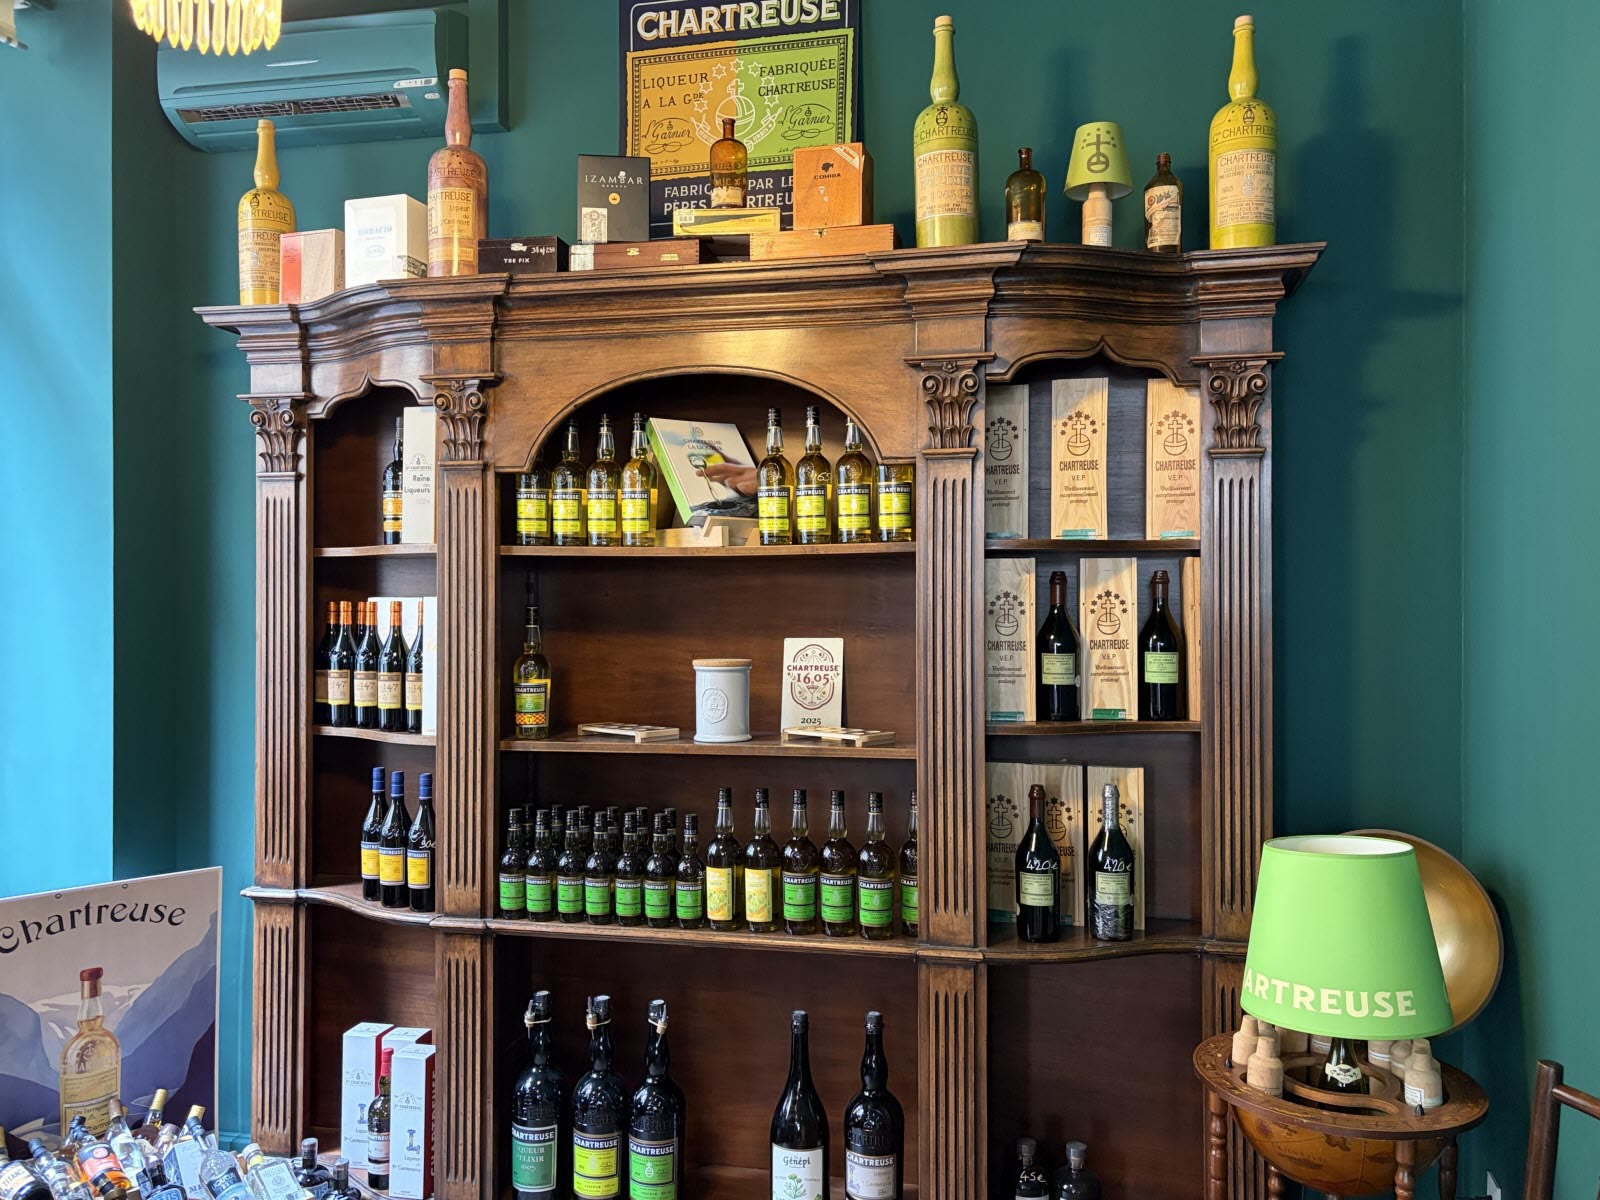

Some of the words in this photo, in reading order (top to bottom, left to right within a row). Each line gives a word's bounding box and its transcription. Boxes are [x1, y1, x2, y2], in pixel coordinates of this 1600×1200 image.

[636, 0, 841, 41] CHARTREUSE
[759, 58, 837, 77] FABRIQUÉE
[642, 72, 709, 89] LIQUEUR
[758, 78, 837, 97] CHARTREUSE
[642, 98, 651, 109] A
[659, 96, 676, 107] LA
[918, 152, 972, 167] CHARTREUSE
[1220, 152, 1275, 167] CHARTREUSE
[585, 174, 644, 184] IZAMBAR
[814, 172, 841, 180] COHIBA
[664, 183, 712, 198] FABRIQ
[748, 177, 774, 190] PAR
[782, 176, 793, 188] LE
[747, 192, 793, 208] RTREU
[240, 208, 289, 222] CHARTREUSE
[358, 225, 392, 236] HORACIO
[1060, 460, 1099, 472] CHARTREUSE
[1156, 460, 1196, 471] CHARTREUSE
[404, 487, 430, 495] Liqueurs
[987, 640, 1027, 652] CHARTREUSE
[1089, 639, 1129, 650] CHARTREUSE
[796, 673, 830, 685] 16.05
[800, 717, 822, 726] 2025
[986, 843, 1019, 854] HARTREUS
[1026, 860, 1058, 870] 420€
[1104, 860, 1132, 872] 420€
[0, 901, 186, 954] Chartreuse
[1243, 968, 1416, 1018] ARTREUSE
[512, 1127, 554, 1141] CHARTREUSE
[575, 1138, 618, 1149] CHARTREUSE
[630, 1144, 674, 1156] CHARTREUSE
[783, 1156, 811, 1168] Génépi
[847, 1153, 894, 1167] CHARTREUSE
[1020, 1170, 1047, 1183] 45€
